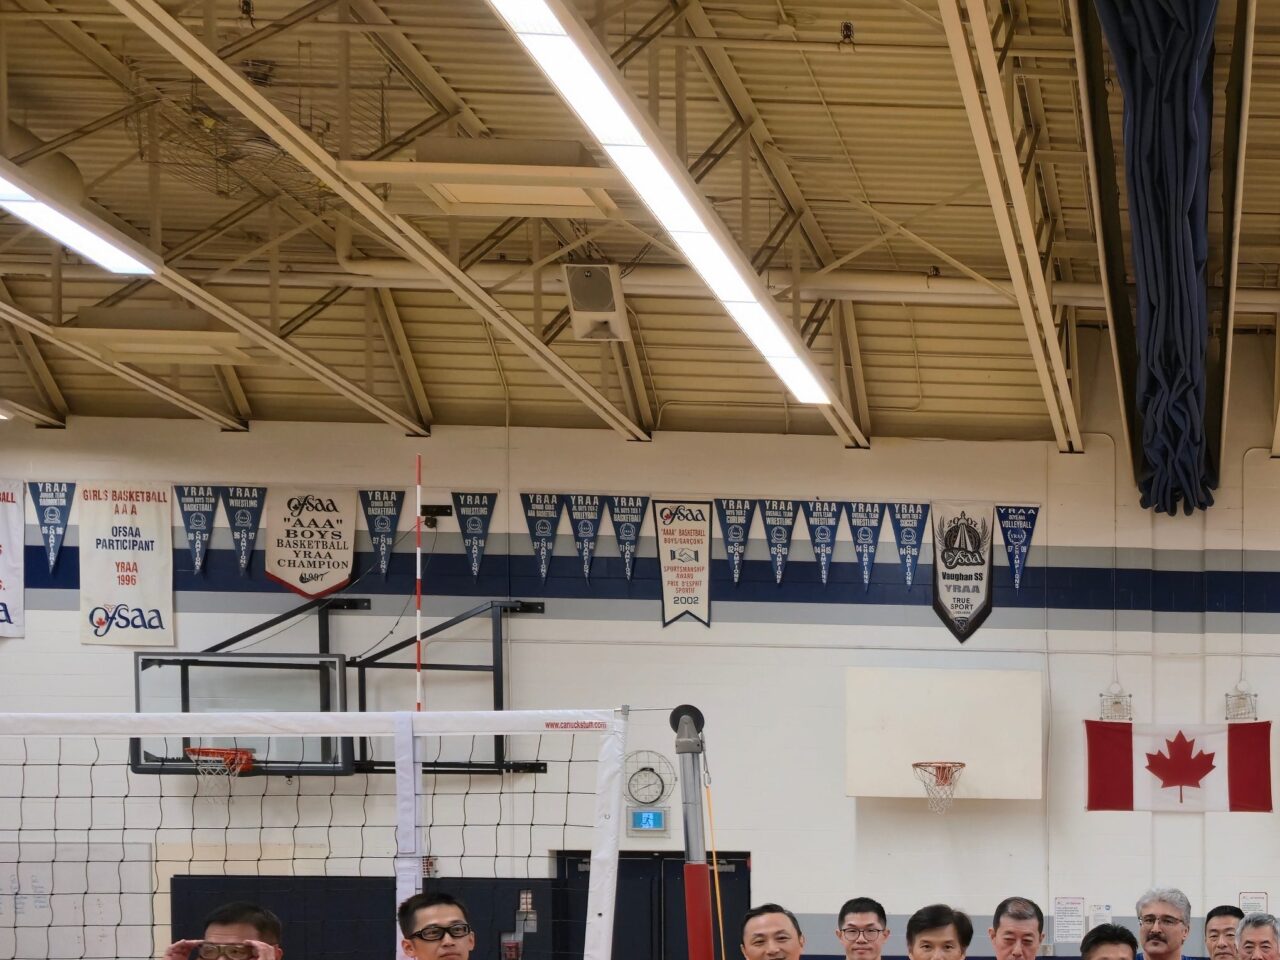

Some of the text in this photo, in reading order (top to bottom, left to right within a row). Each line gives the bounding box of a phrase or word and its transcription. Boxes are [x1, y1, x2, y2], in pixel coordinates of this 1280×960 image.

[38, 483, 67, 492] YRAA
[184, 487, 212, 496] YRAA
[229, 488, 258, 497] YRAA
[83, 490, 167, 502] GIRLS BASKETBALL
[368, 491, 397, 501] YRAA
[460, 495, 488, 505] YRAA
[529, 494, 557, 504] YRAA
[571, 496, 599, 505] YRAA
[229, 499, 258, 508] WRESTLING
[614, 497, 642, 507] YRAA
[722, 500, 750, 510] YRAA
[765, 501, 793, 511] YRAA
[809, 502, 837, 512] YRAA
[183, 503, 212, 512] BASKETBALL
[368, 507, 397, 515] BASKETBALL
[851, 503, 880, 513] YRAA
[894, 504, 922, 514] YRAA
[112, 526, 141, 537] OFSAA
[285, 530, 342, 540] BOYS
[679, 529, 706, 537] BASKETBALL
[96, 538, 155, 551] PARTICIPANT
[277, 539, 348, 550] BASKETBALL
[293, 550, 333, 560] YRAA
[115, 562, 138, 573] YRAA
[277, 559, 349, 569] CHAMPION
[117, 574, 136, 586] 1996
[942, 572, 983, 582] Vaughan SS
[944, 585, 980, 593] YRAA
